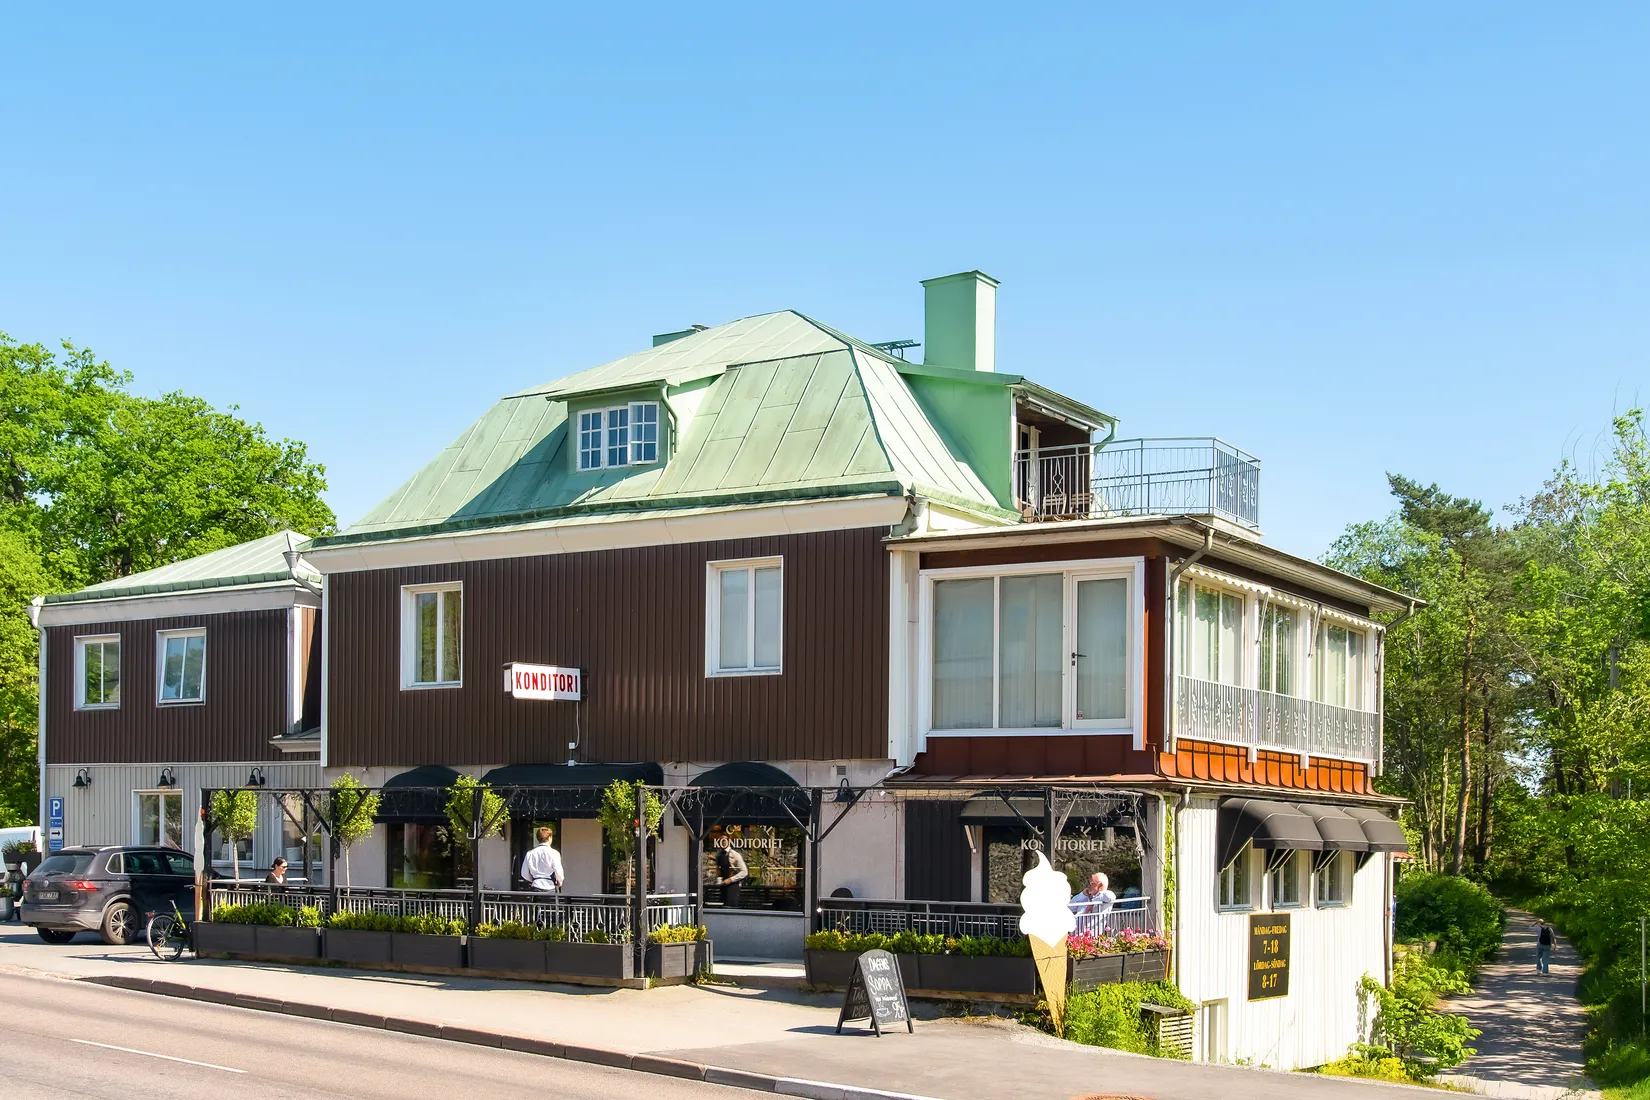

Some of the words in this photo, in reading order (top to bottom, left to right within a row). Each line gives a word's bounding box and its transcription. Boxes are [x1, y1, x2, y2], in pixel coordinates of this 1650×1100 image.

[516, 672, 578, 693] KONDITORI
[52, 800, 60, 816] P
[713, 838, 783, 848] KONDITORIET
[1020, 839, 1105, 850] KONITORIET
[1263, 939, 1279, 954] 7-18
[867, 975, 893, 994] SOPPA
[1262, 973, 1278, 988] 8-17
